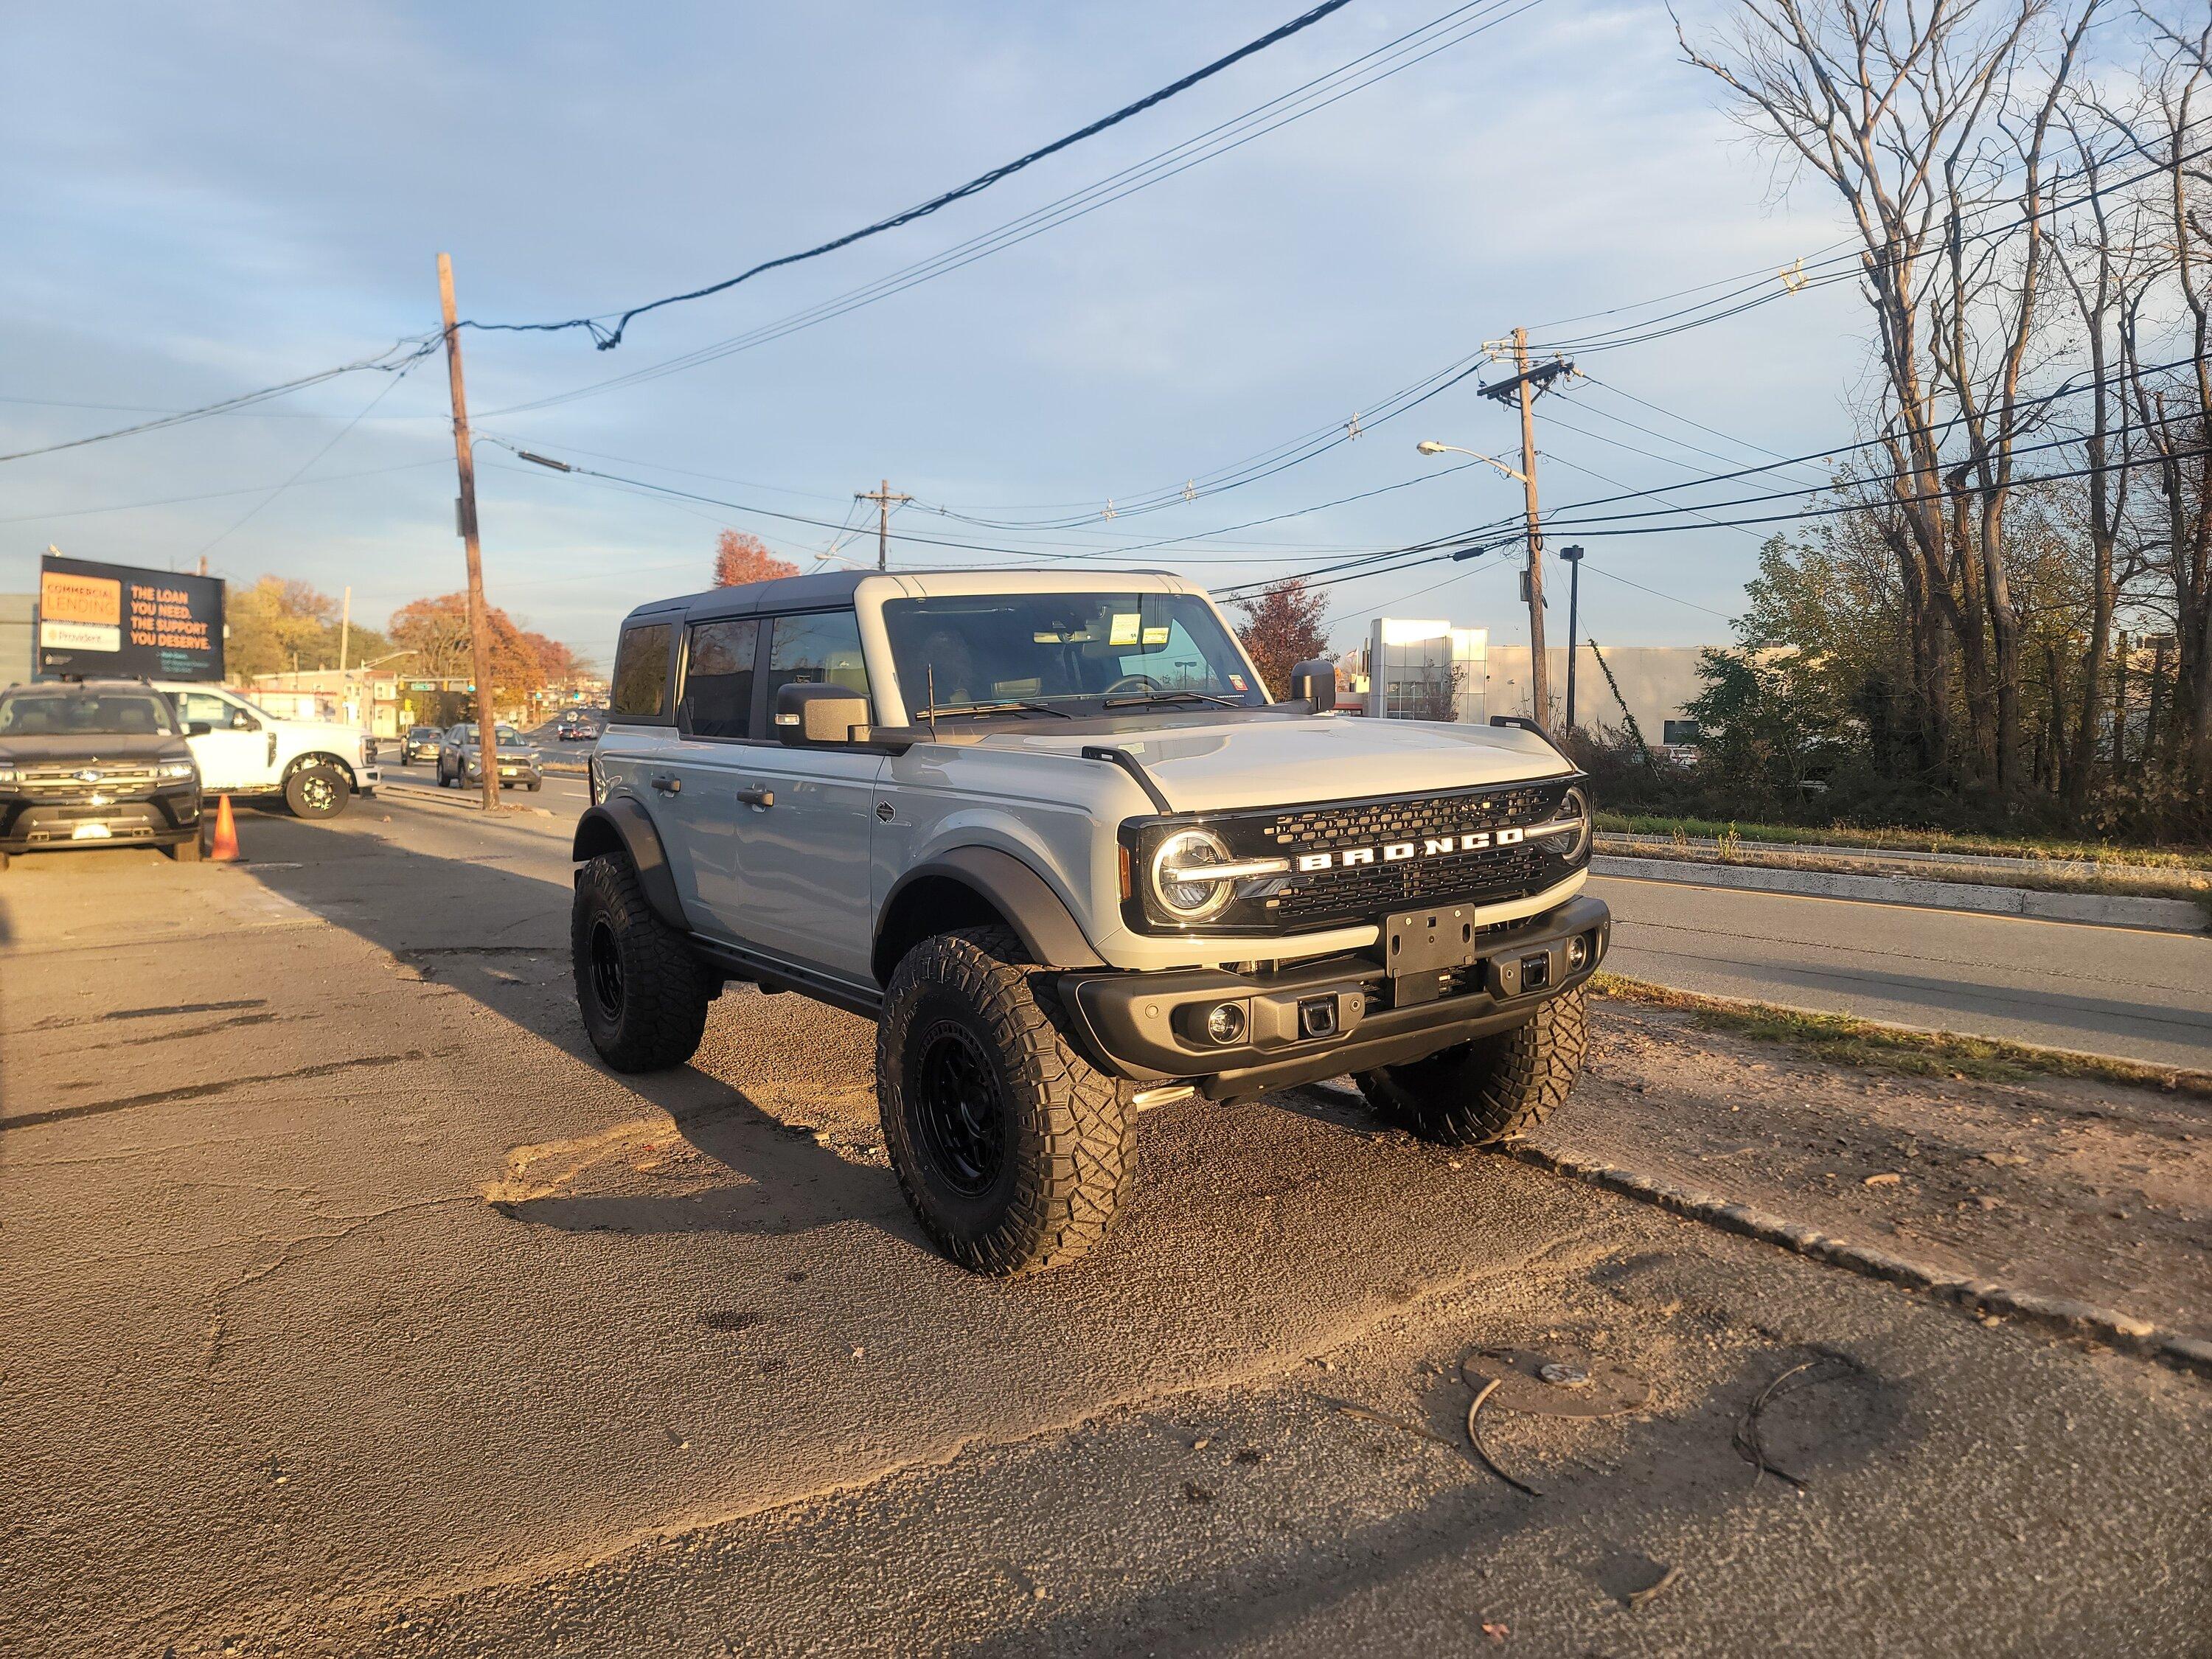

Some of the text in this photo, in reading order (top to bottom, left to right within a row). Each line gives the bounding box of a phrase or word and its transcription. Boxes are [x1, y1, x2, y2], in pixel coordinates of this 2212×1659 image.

[47, 583, 115, 599] COMMERCIAL
[131, 585, 189, 605] THE LOAN
[47, 596, 116, 616] LENDING
[131, 600, 192, 619] YOU NEED.
[131, 616, 208, 636] THE SUPPORT
[131, 631, 212, 650] YOU DESERVE.
[1298, 828, 1524, 872] BRONCO
